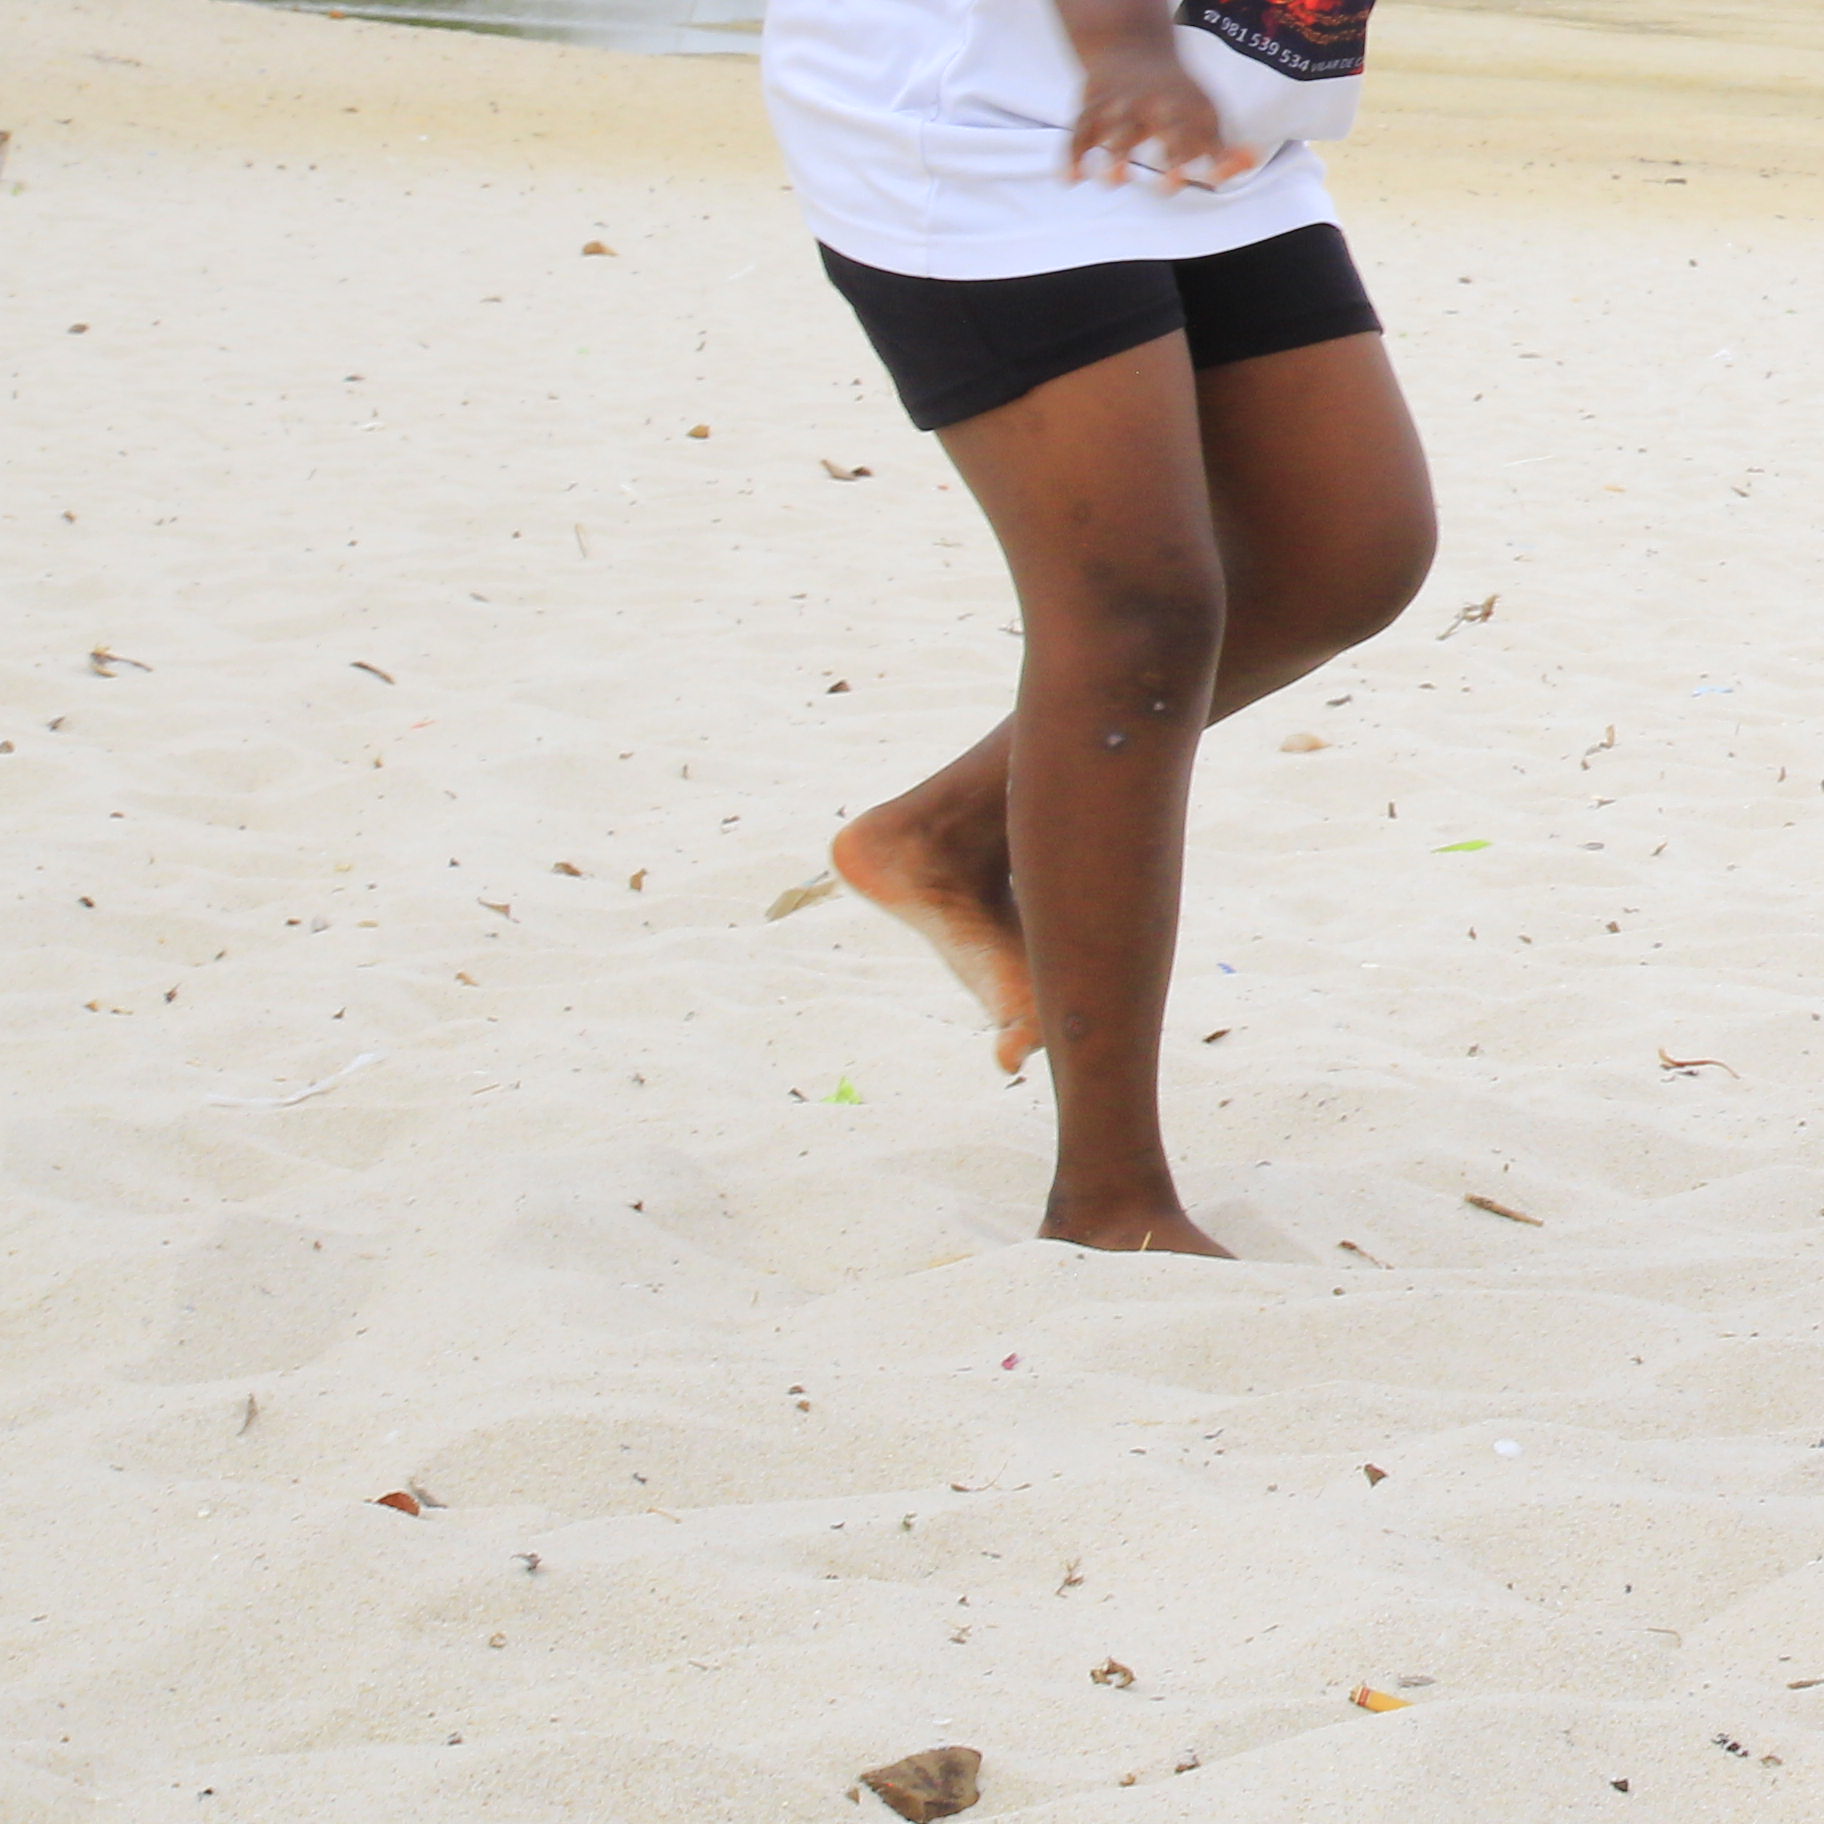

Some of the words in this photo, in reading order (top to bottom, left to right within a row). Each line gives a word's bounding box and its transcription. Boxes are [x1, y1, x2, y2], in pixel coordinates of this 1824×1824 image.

[1220, 16, 1249, 43] 981
[1248, 33, 1281, 57] 539
[1279, 49, 1311, 72] 534
